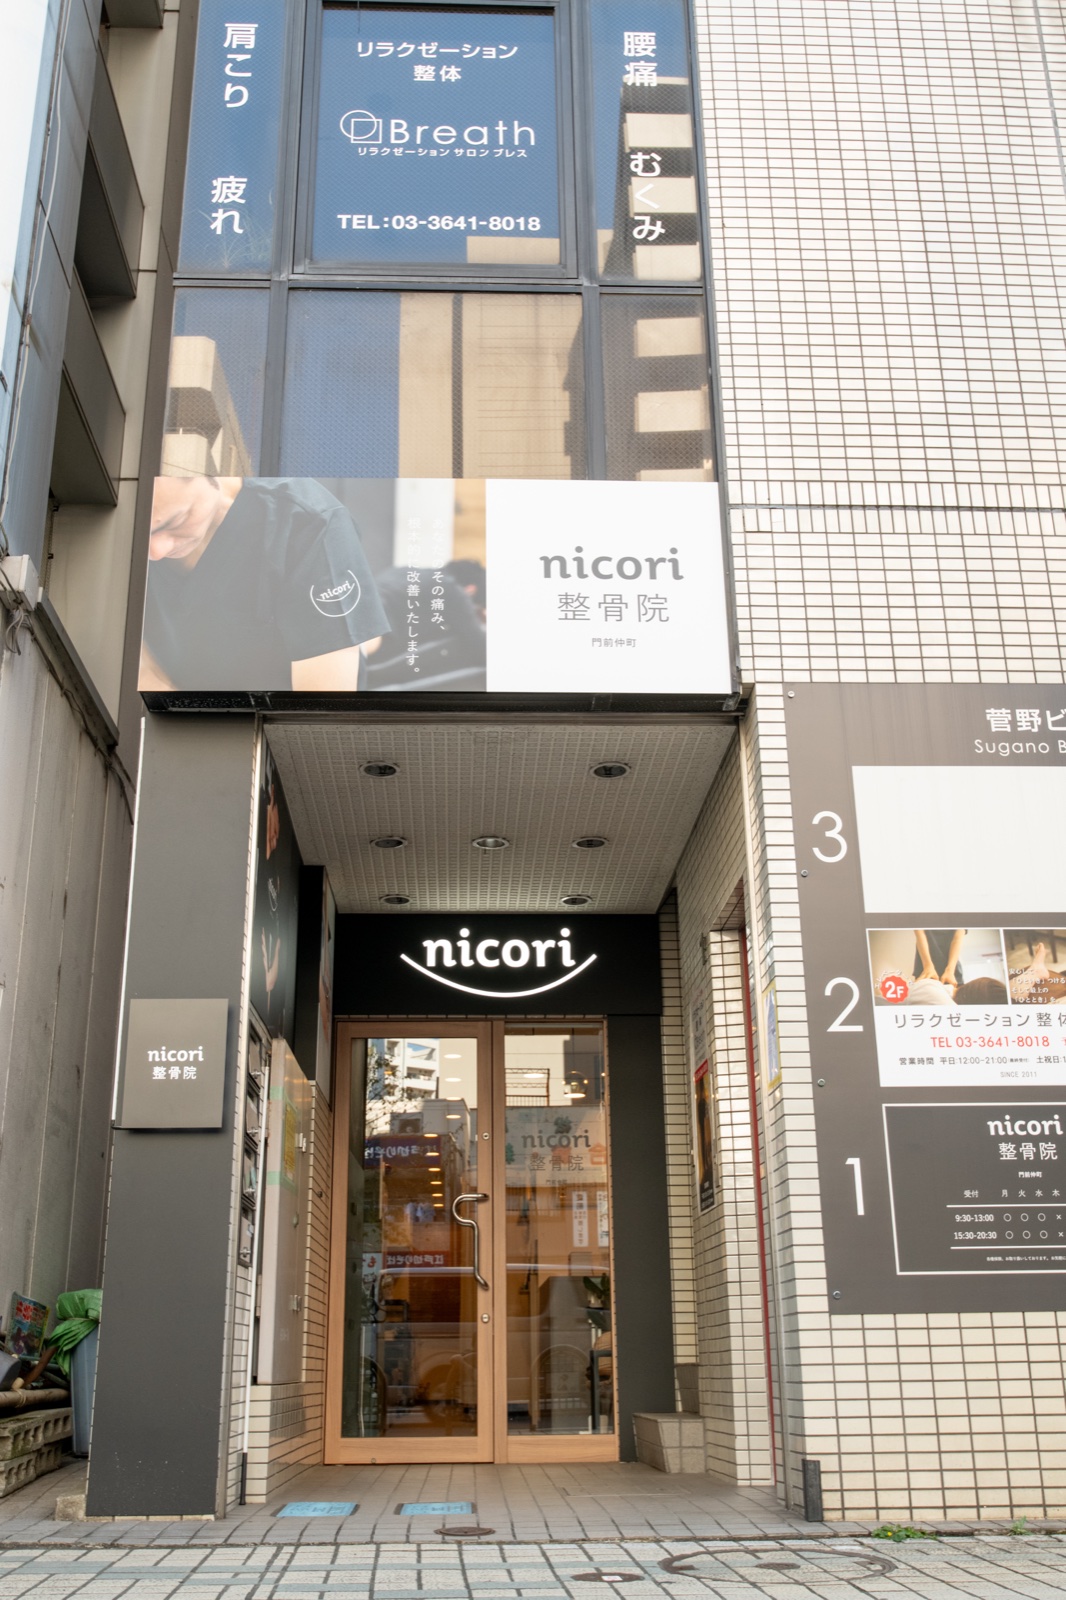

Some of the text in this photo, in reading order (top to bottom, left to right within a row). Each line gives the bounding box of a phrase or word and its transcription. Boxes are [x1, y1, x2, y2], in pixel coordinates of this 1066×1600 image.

[356, 41, 519, 60] リラクゼーション
[622, 31, 658, 88] 腰痛
[223, 22, 258, 108] 肩こり
[413, 65, 463, 83] 整体
[389, 119, 536, 146] Breath
[357, 147, 451, 158] リラクゼーション
[454, 148, 490, 158] サロン
[210, 176, 247, 236] 疲れ
[629, 151, 666, 242] むくみ
[539, 545, 685, 581] nicori
[319, 580, 352, 600] nicori
[557, 592, 671, 623] 整骨院
[591, 637, 638, 649] 門前仲町
[985, 707, 1066, 733] 菅野ビ
[974, 739, 1050, 757] Sugano
[811, 810, 848, 863] 3
[422, 927, 577, 968] nicori
[884, 980, 905, 999] 2F
[824, 977, 864, 1032] 2
[930, 1036, 952, 1049] TEL
[956, 1035, 1050, 1049] 03-3641-8018
[146, 1045, 205, 1063] nicori
[898, 1056, 935, 1066] 営業時間
[152, 1065, 198, 1080] 整骨院
[1022, 1070, 1038, 1078] 2011
[987, 1113, 1064, 1137] nicori
[520, 1129, 592, 1149] nicori
[998, 1141, 1058, 1161] 整骨院
[529, 1155, 585, 1172] 整骨院
[844, 1157, 865, 1216] 1
[963, 1189, 1060, 1199] 受付 月 火 水 木
[955, 1214, 995, 1223] 9:30-13:00
[953, 1231, 997, 1240] 15:30-20:30
